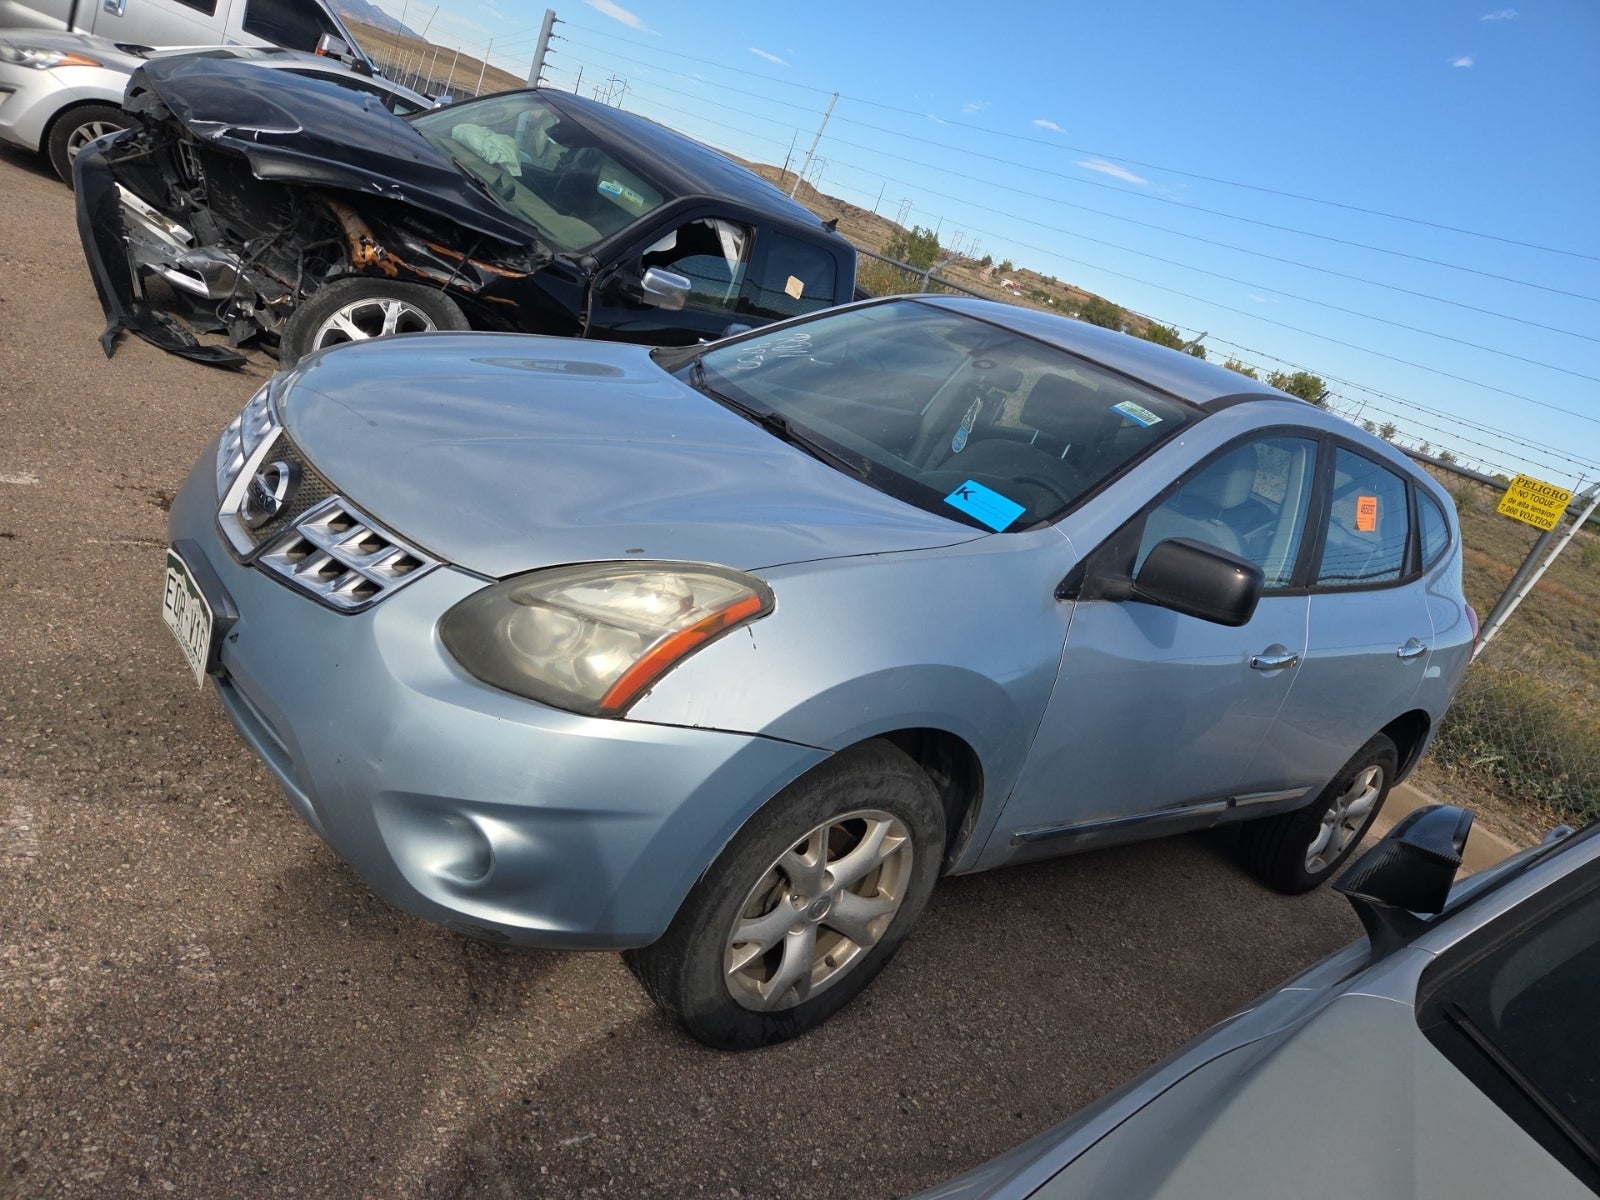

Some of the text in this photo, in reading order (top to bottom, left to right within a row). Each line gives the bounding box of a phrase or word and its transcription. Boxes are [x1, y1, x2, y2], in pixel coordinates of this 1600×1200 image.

[955, 486, 976, 501] K
[1515, 477, 1569, 502] PELIGRO
[1518, 489, 1555, 508] NO TOQUE
[1519, 510, 1553, 528] VOLTIOS
